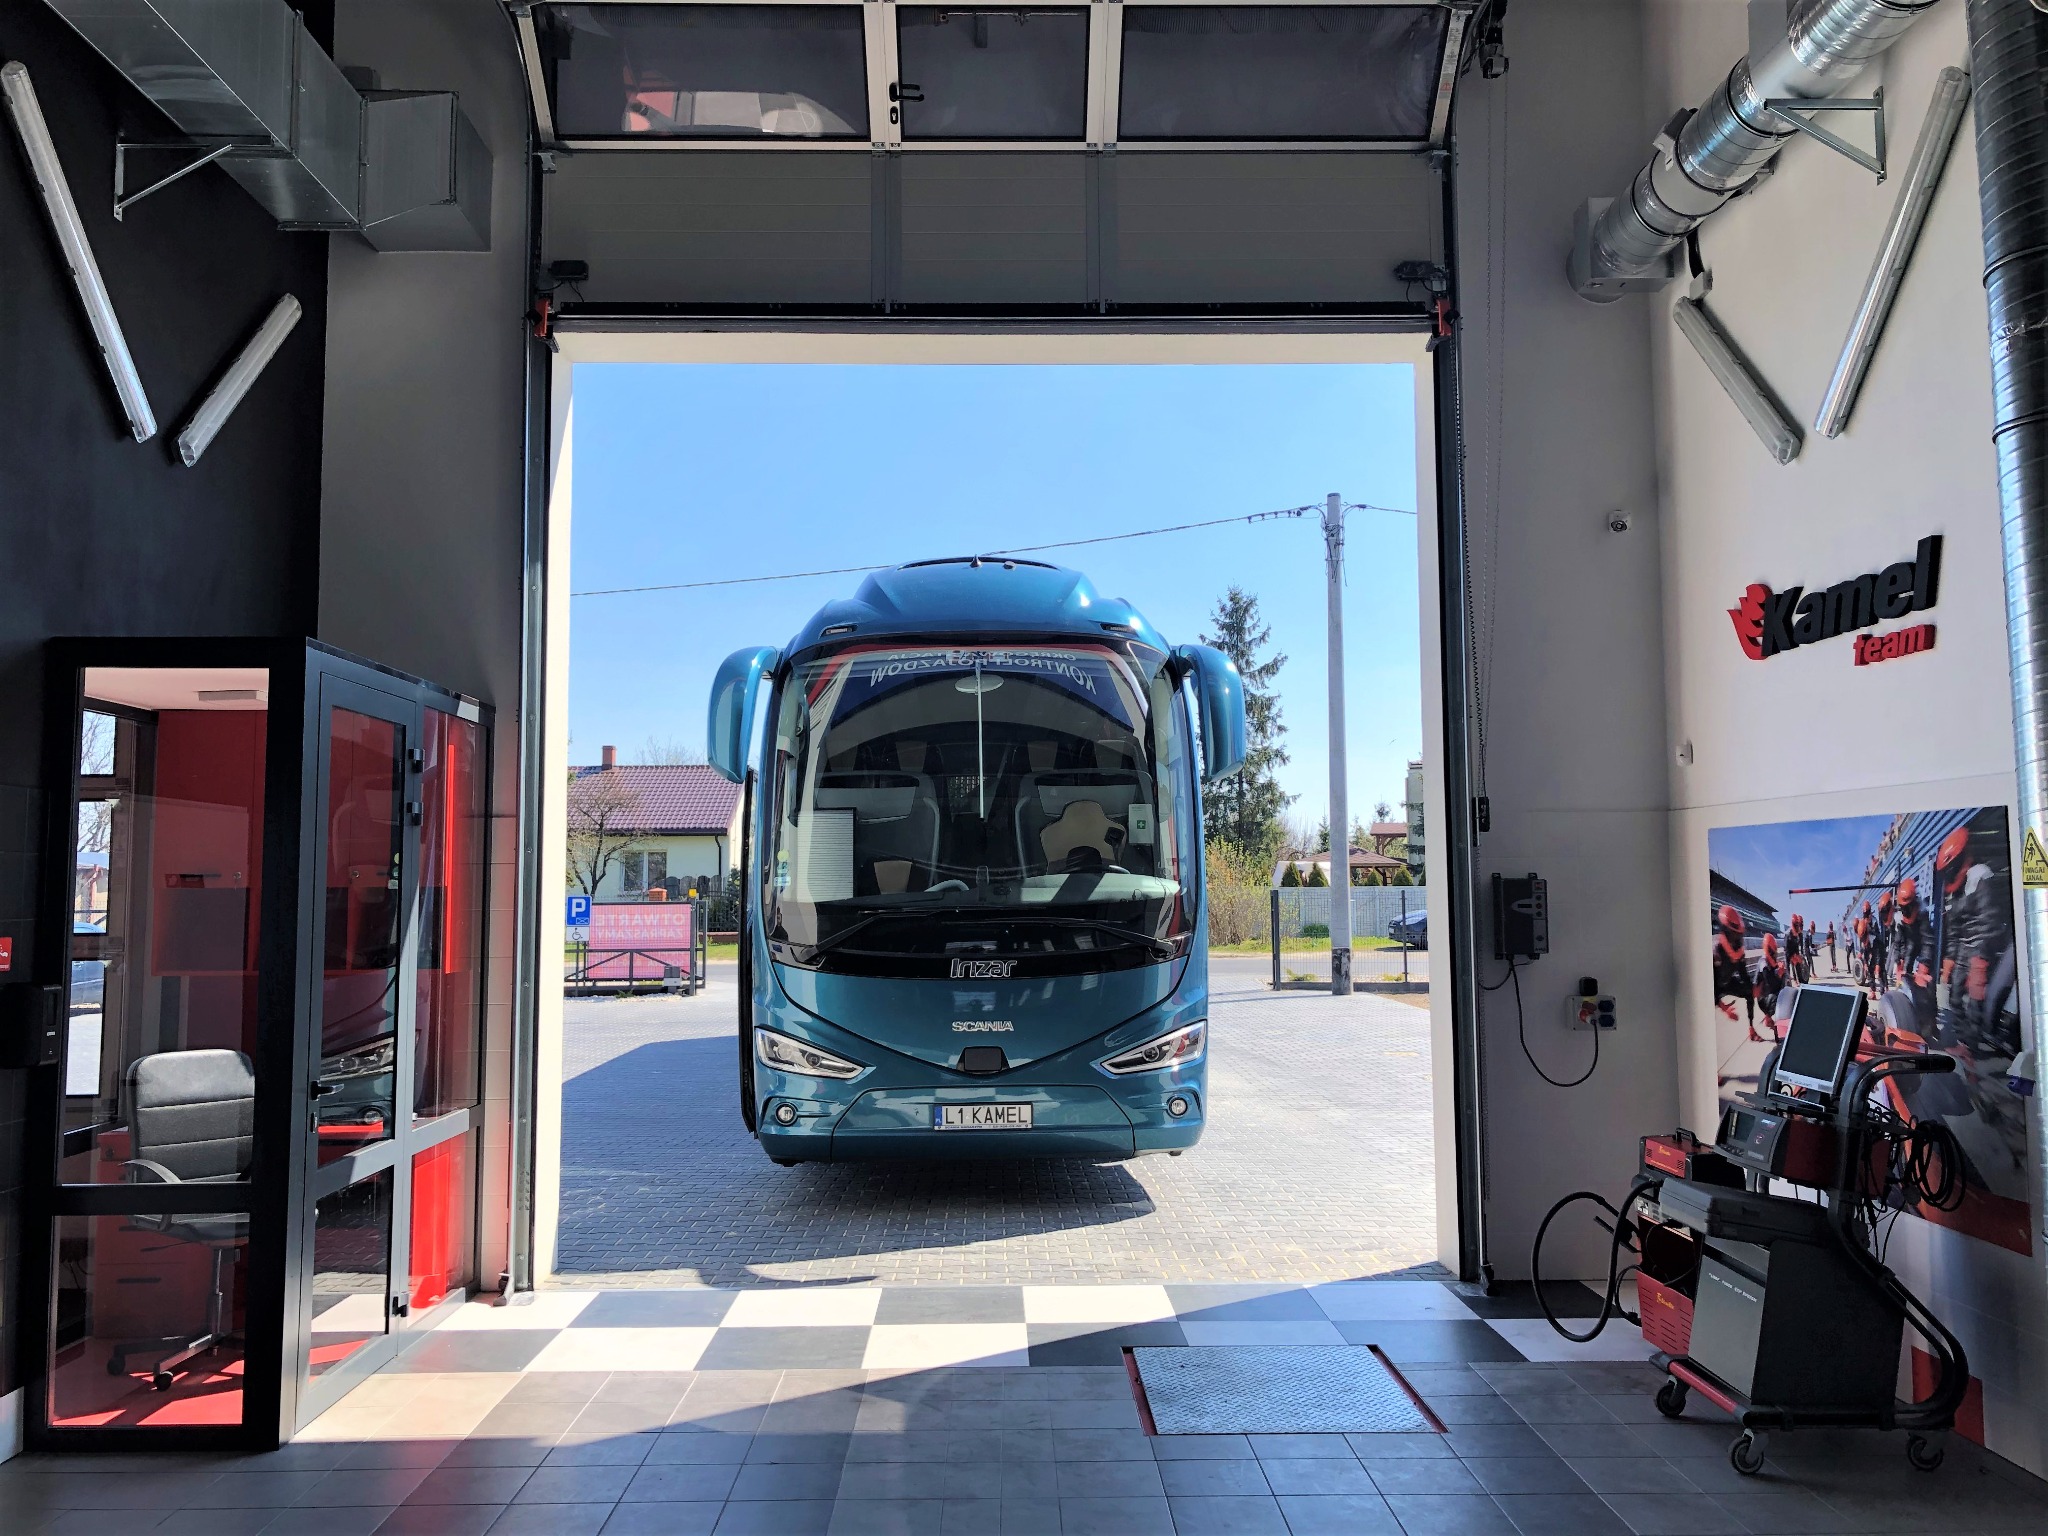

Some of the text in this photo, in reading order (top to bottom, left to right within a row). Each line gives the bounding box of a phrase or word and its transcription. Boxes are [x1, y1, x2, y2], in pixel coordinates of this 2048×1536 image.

[1761, 534, 1943, 657] Kamel
[1853, 624, 1935, 666] team
[572, 898, 586, 917] P
[950, 958, 1018, 979] Irizar
[951, 1020, 1015, 1032] SCANIA
[945, 1106, 1028, 1124] L1 KAMEL
